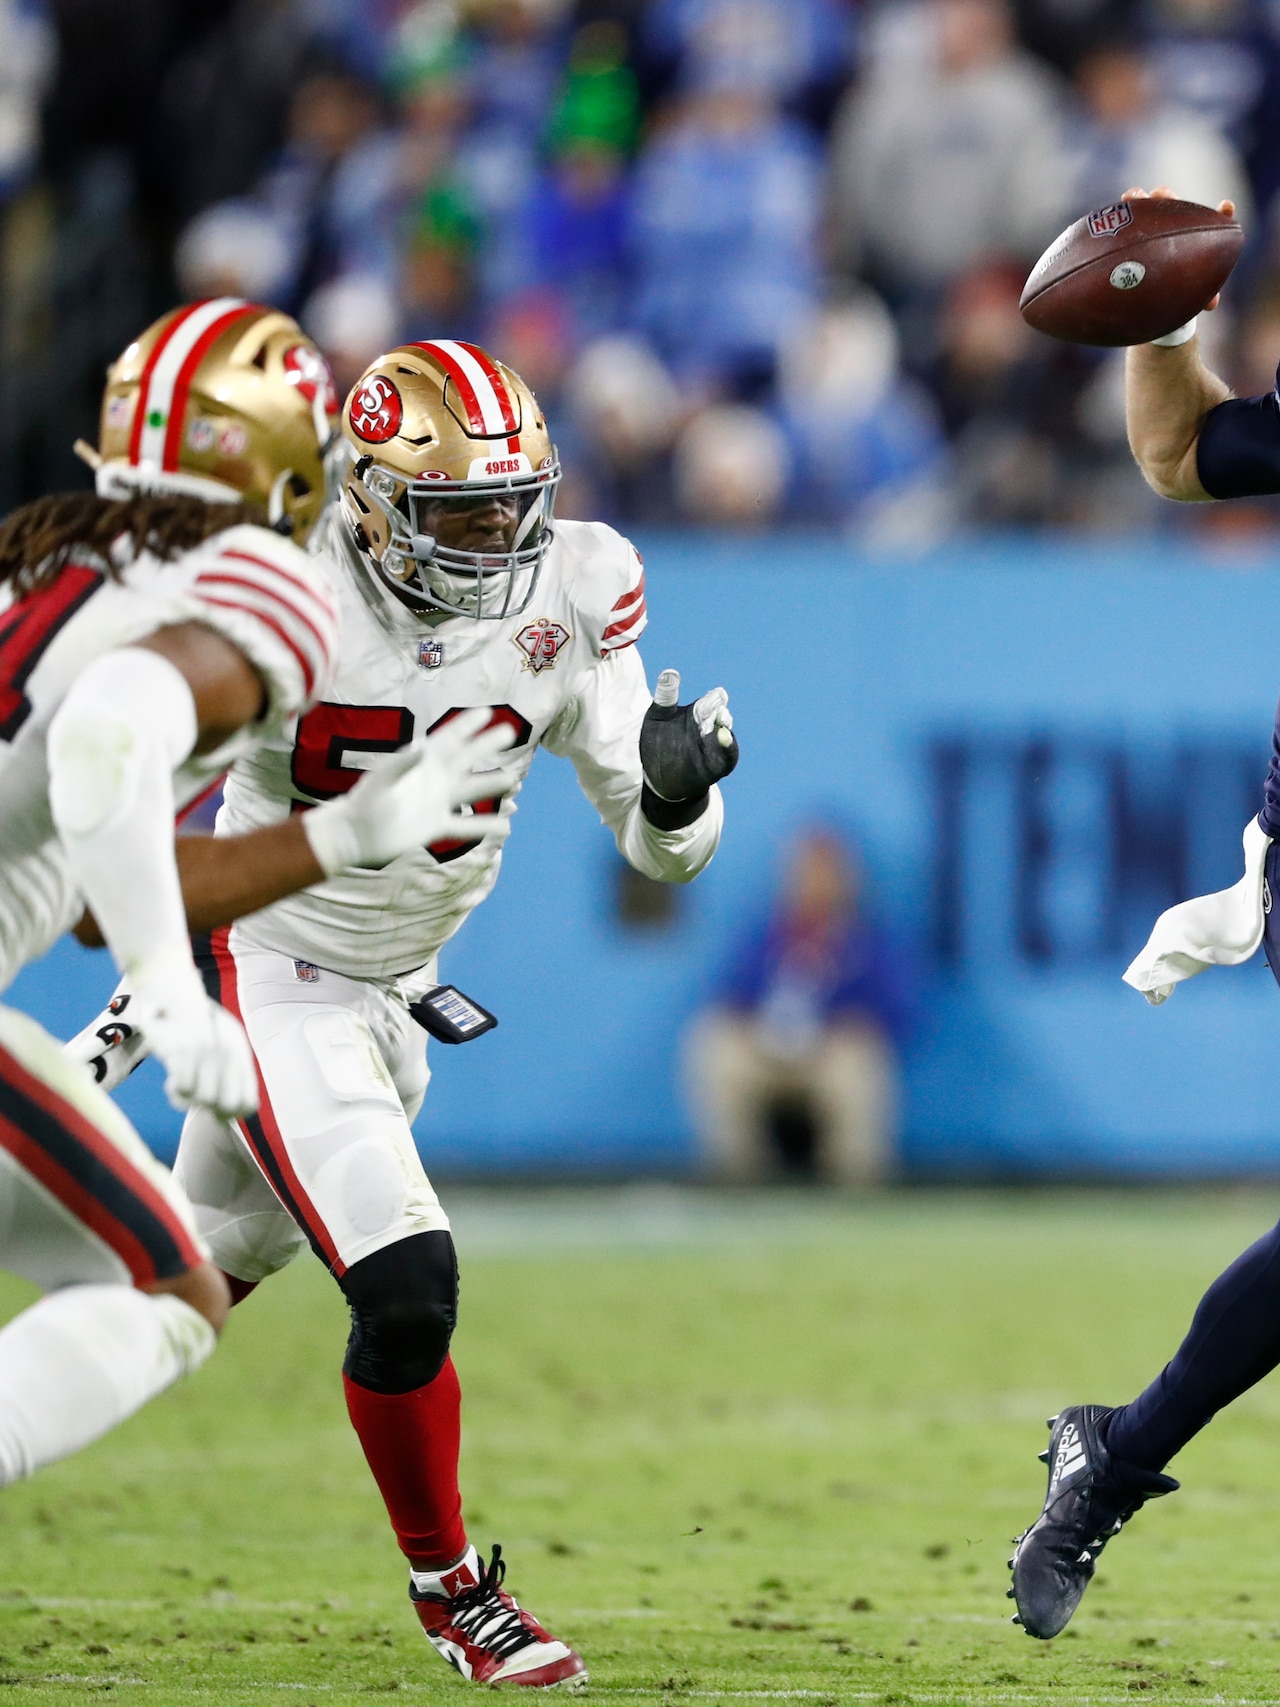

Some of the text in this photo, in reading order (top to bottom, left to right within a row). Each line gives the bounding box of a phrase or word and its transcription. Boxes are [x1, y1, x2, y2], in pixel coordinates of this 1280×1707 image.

[1093, 210, 1129, 233] NFL
[1119, 273, 1138, 289] 384
[484, 458, 521, 475] 49ERS
[526, 630, 559, 659] 75
